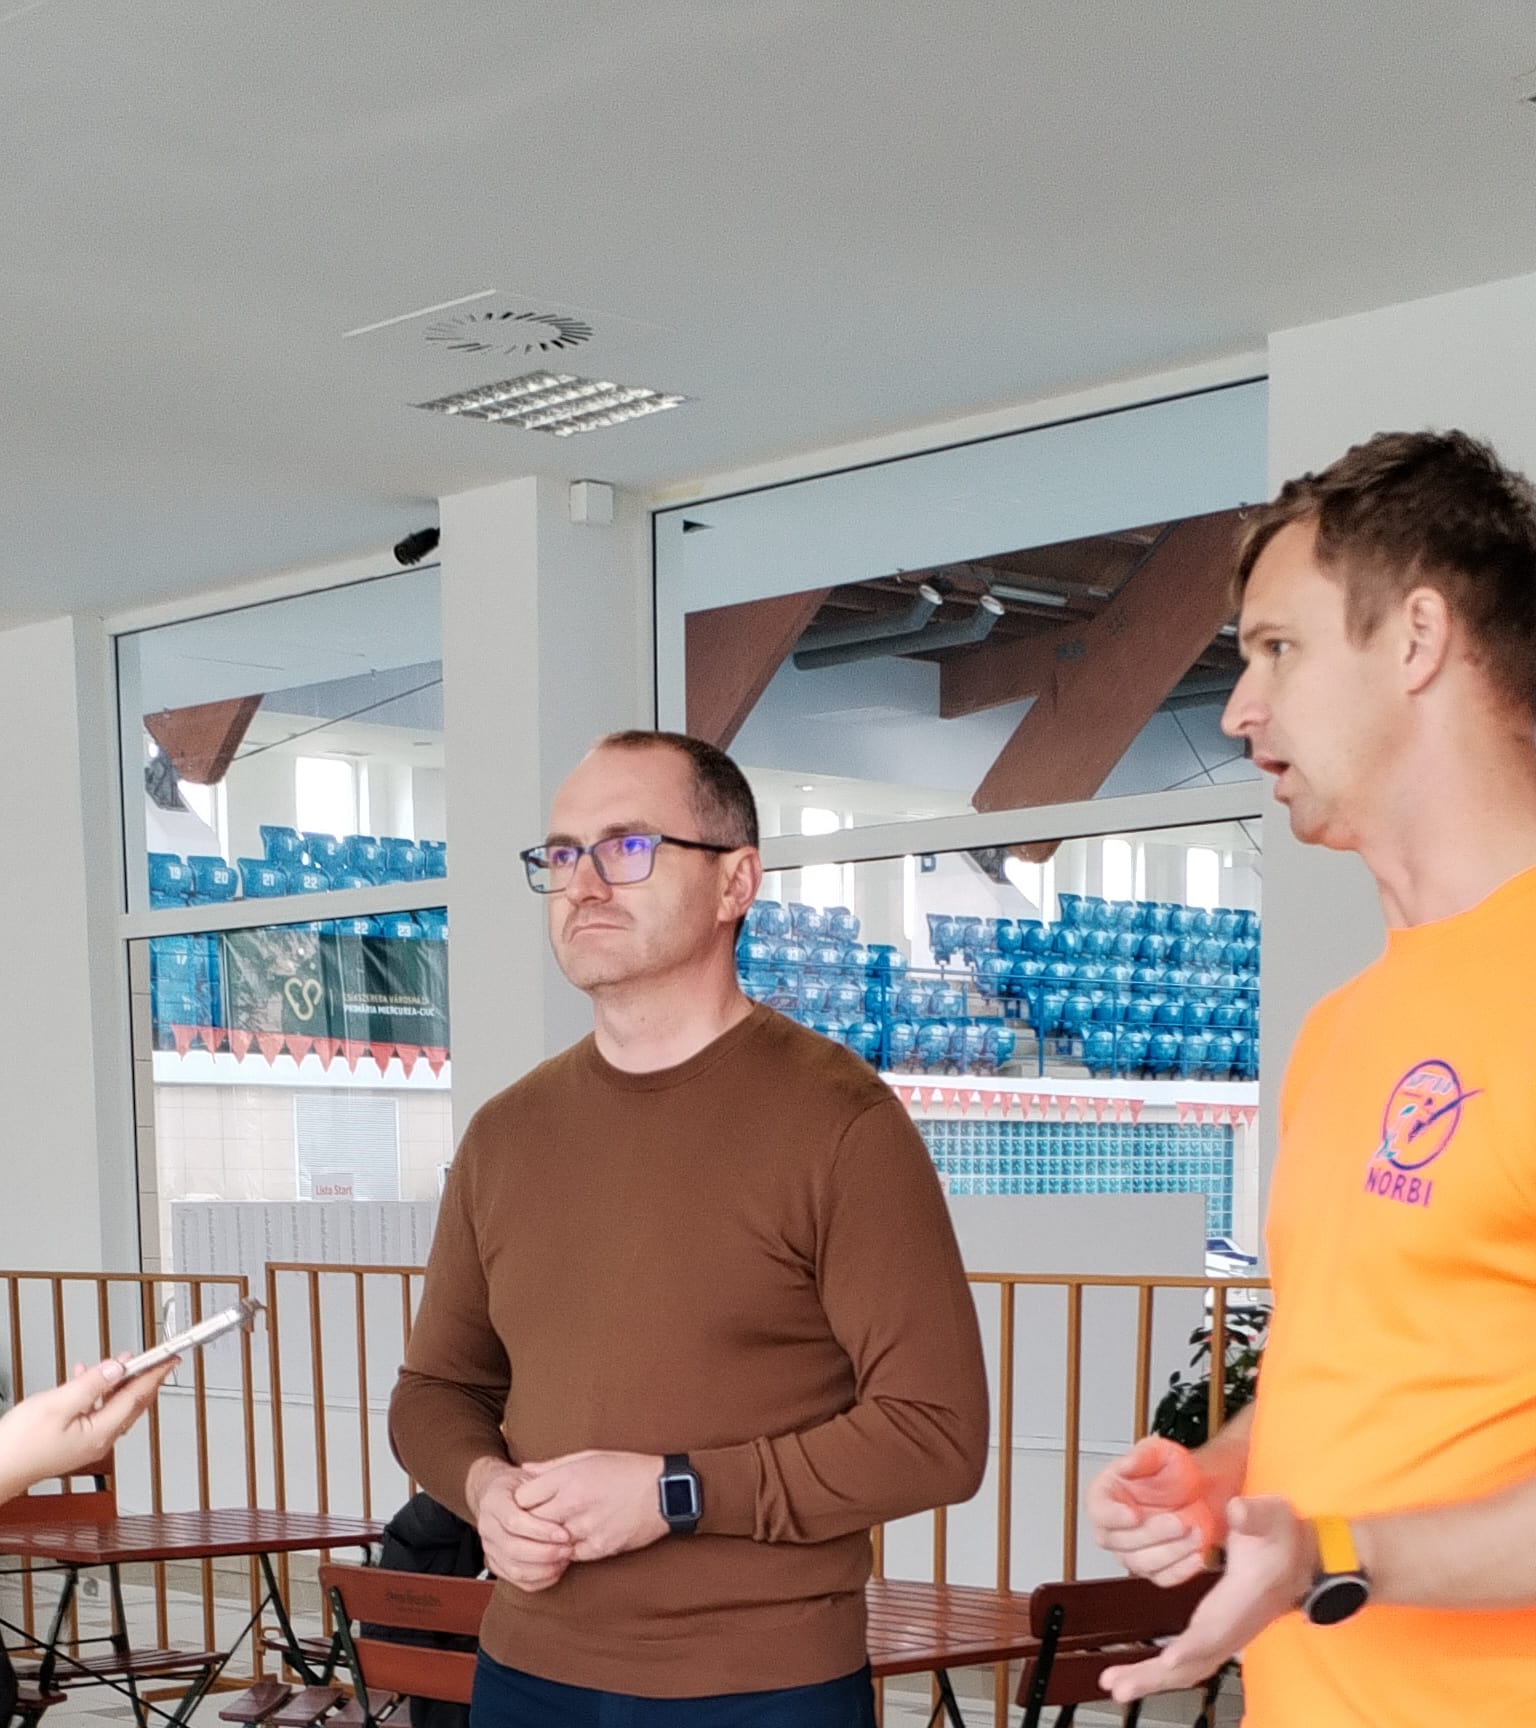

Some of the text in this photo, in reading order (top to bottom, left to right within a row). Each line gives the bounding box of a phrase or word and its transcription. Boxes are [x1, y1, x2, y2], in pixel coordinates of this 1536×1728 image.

[213, 871, 229, 885] 20
[262, 872, 275, 886] 21
[1365, 1166, 1433, 1206] NORBI
